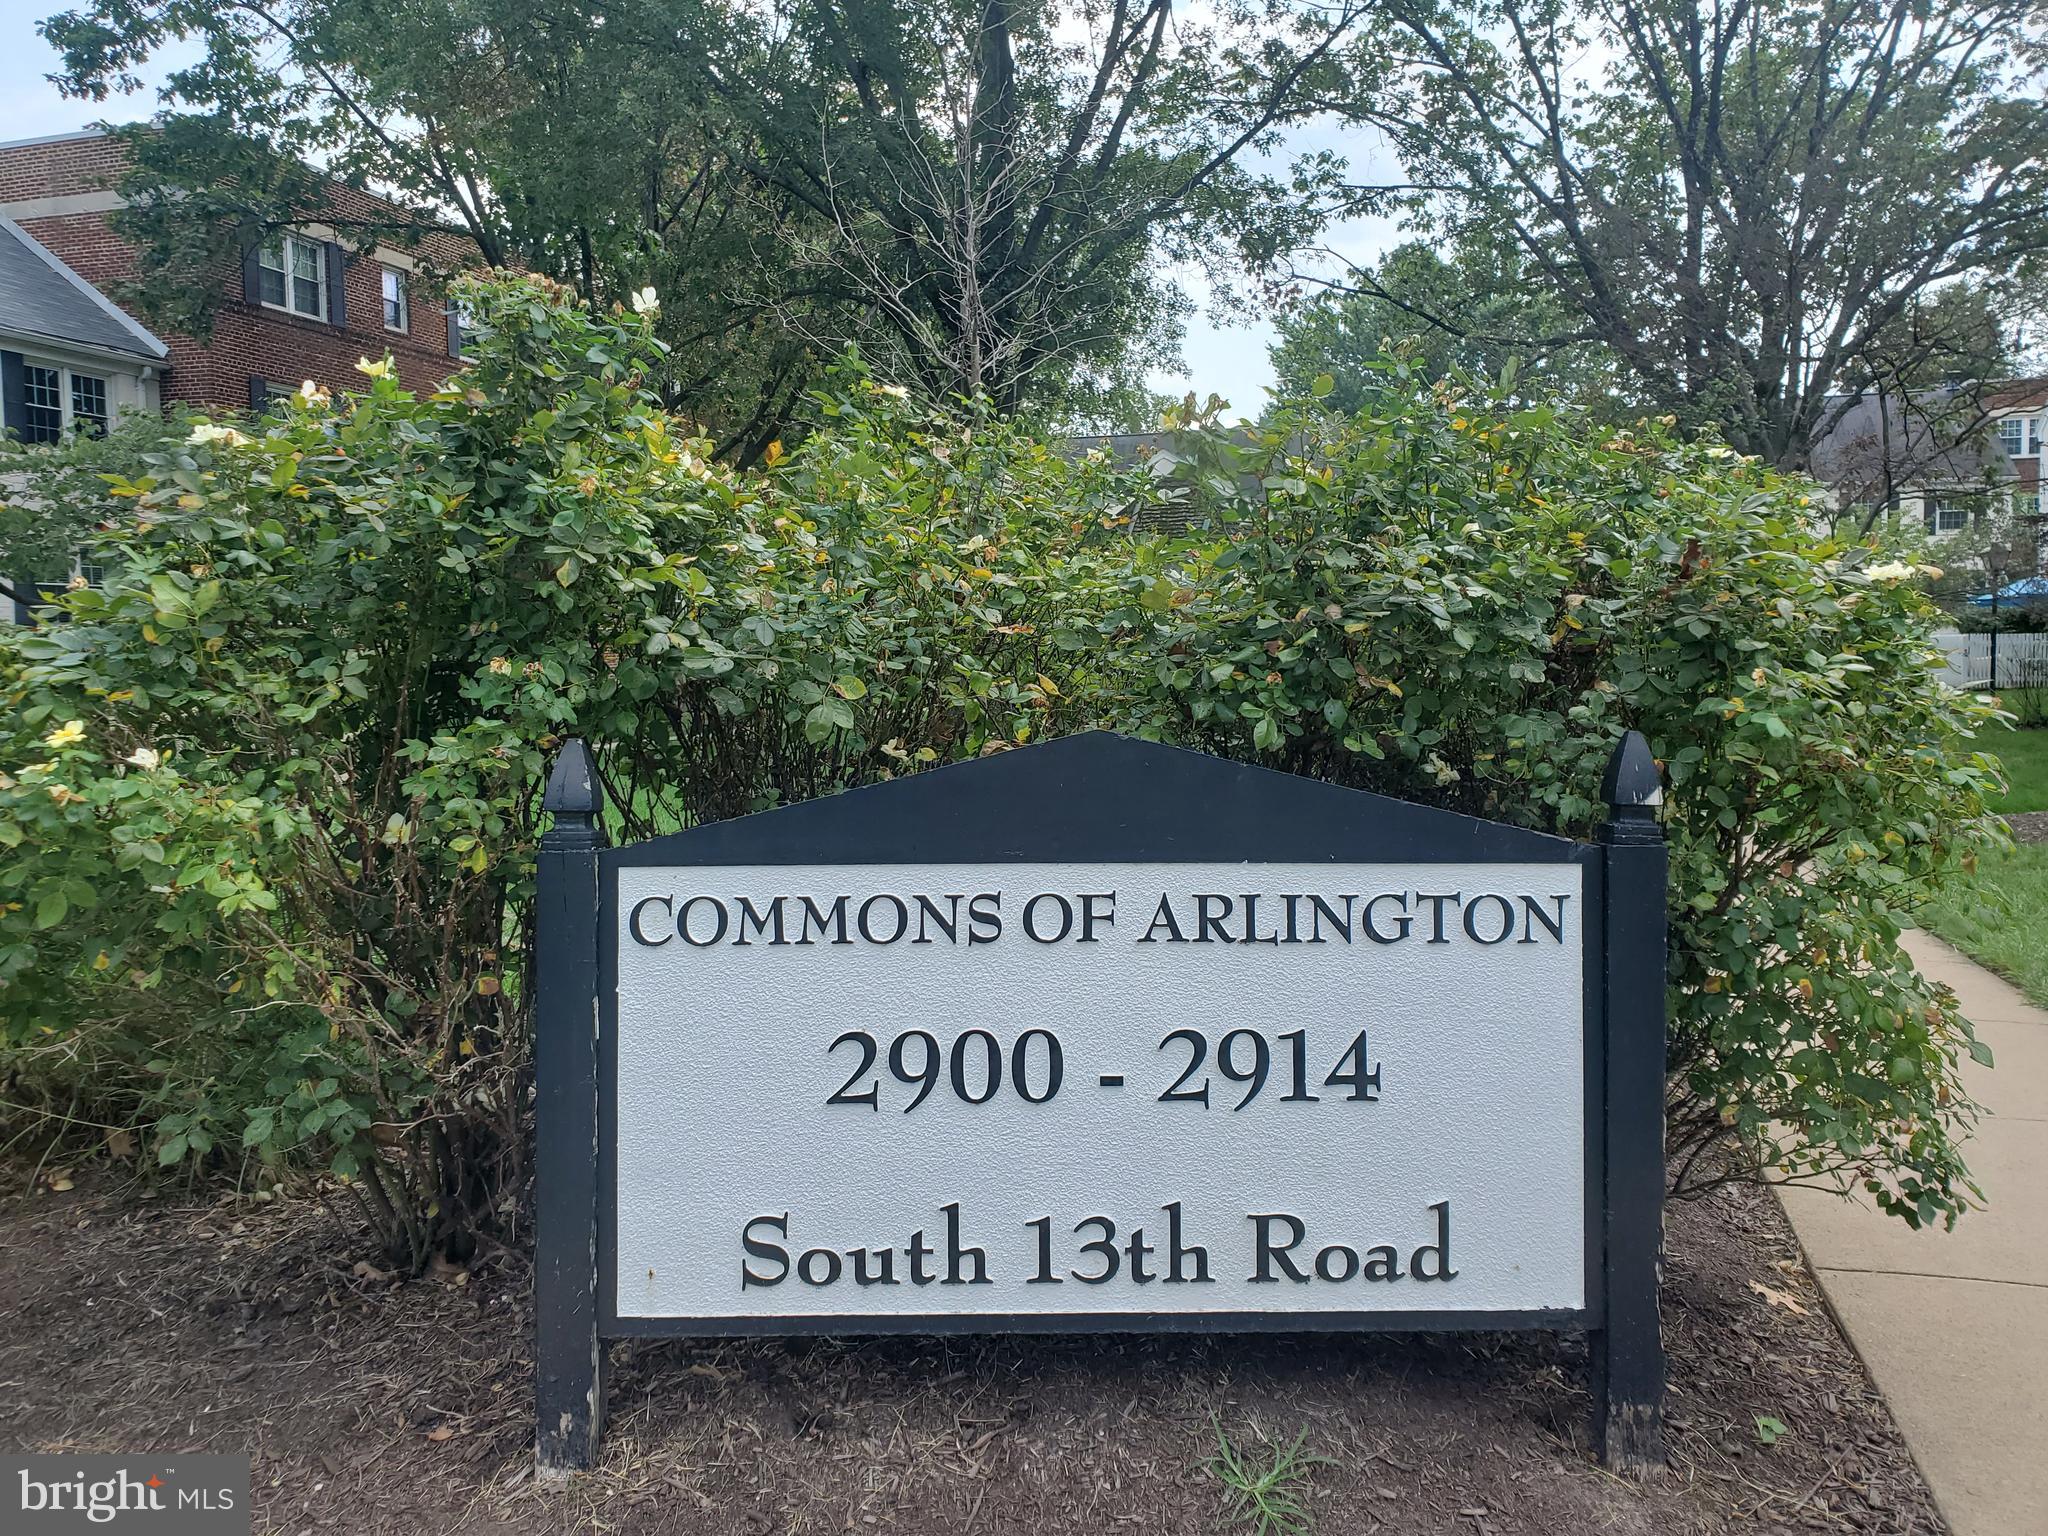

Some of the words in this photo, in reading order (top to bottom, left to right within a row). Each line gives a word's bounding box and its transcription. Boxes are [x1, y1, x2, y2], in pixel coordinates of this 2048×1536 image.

[630, 890, 1002, 946] COMMONS
[1023, 890, 1115, 945] OF
[1137, 890, 1571, 946] ARLINGTON
[826, 1029, 1063, 1114] 2900
[1100, 1075, 1124, 1087] -
[1158, 1029, 1381, 1112] 2914
[742, 1202, 993, 1289] South
[1025, 1202, 1216, 1286] 13th
[1247, 1201, 1459, 1284] Road
